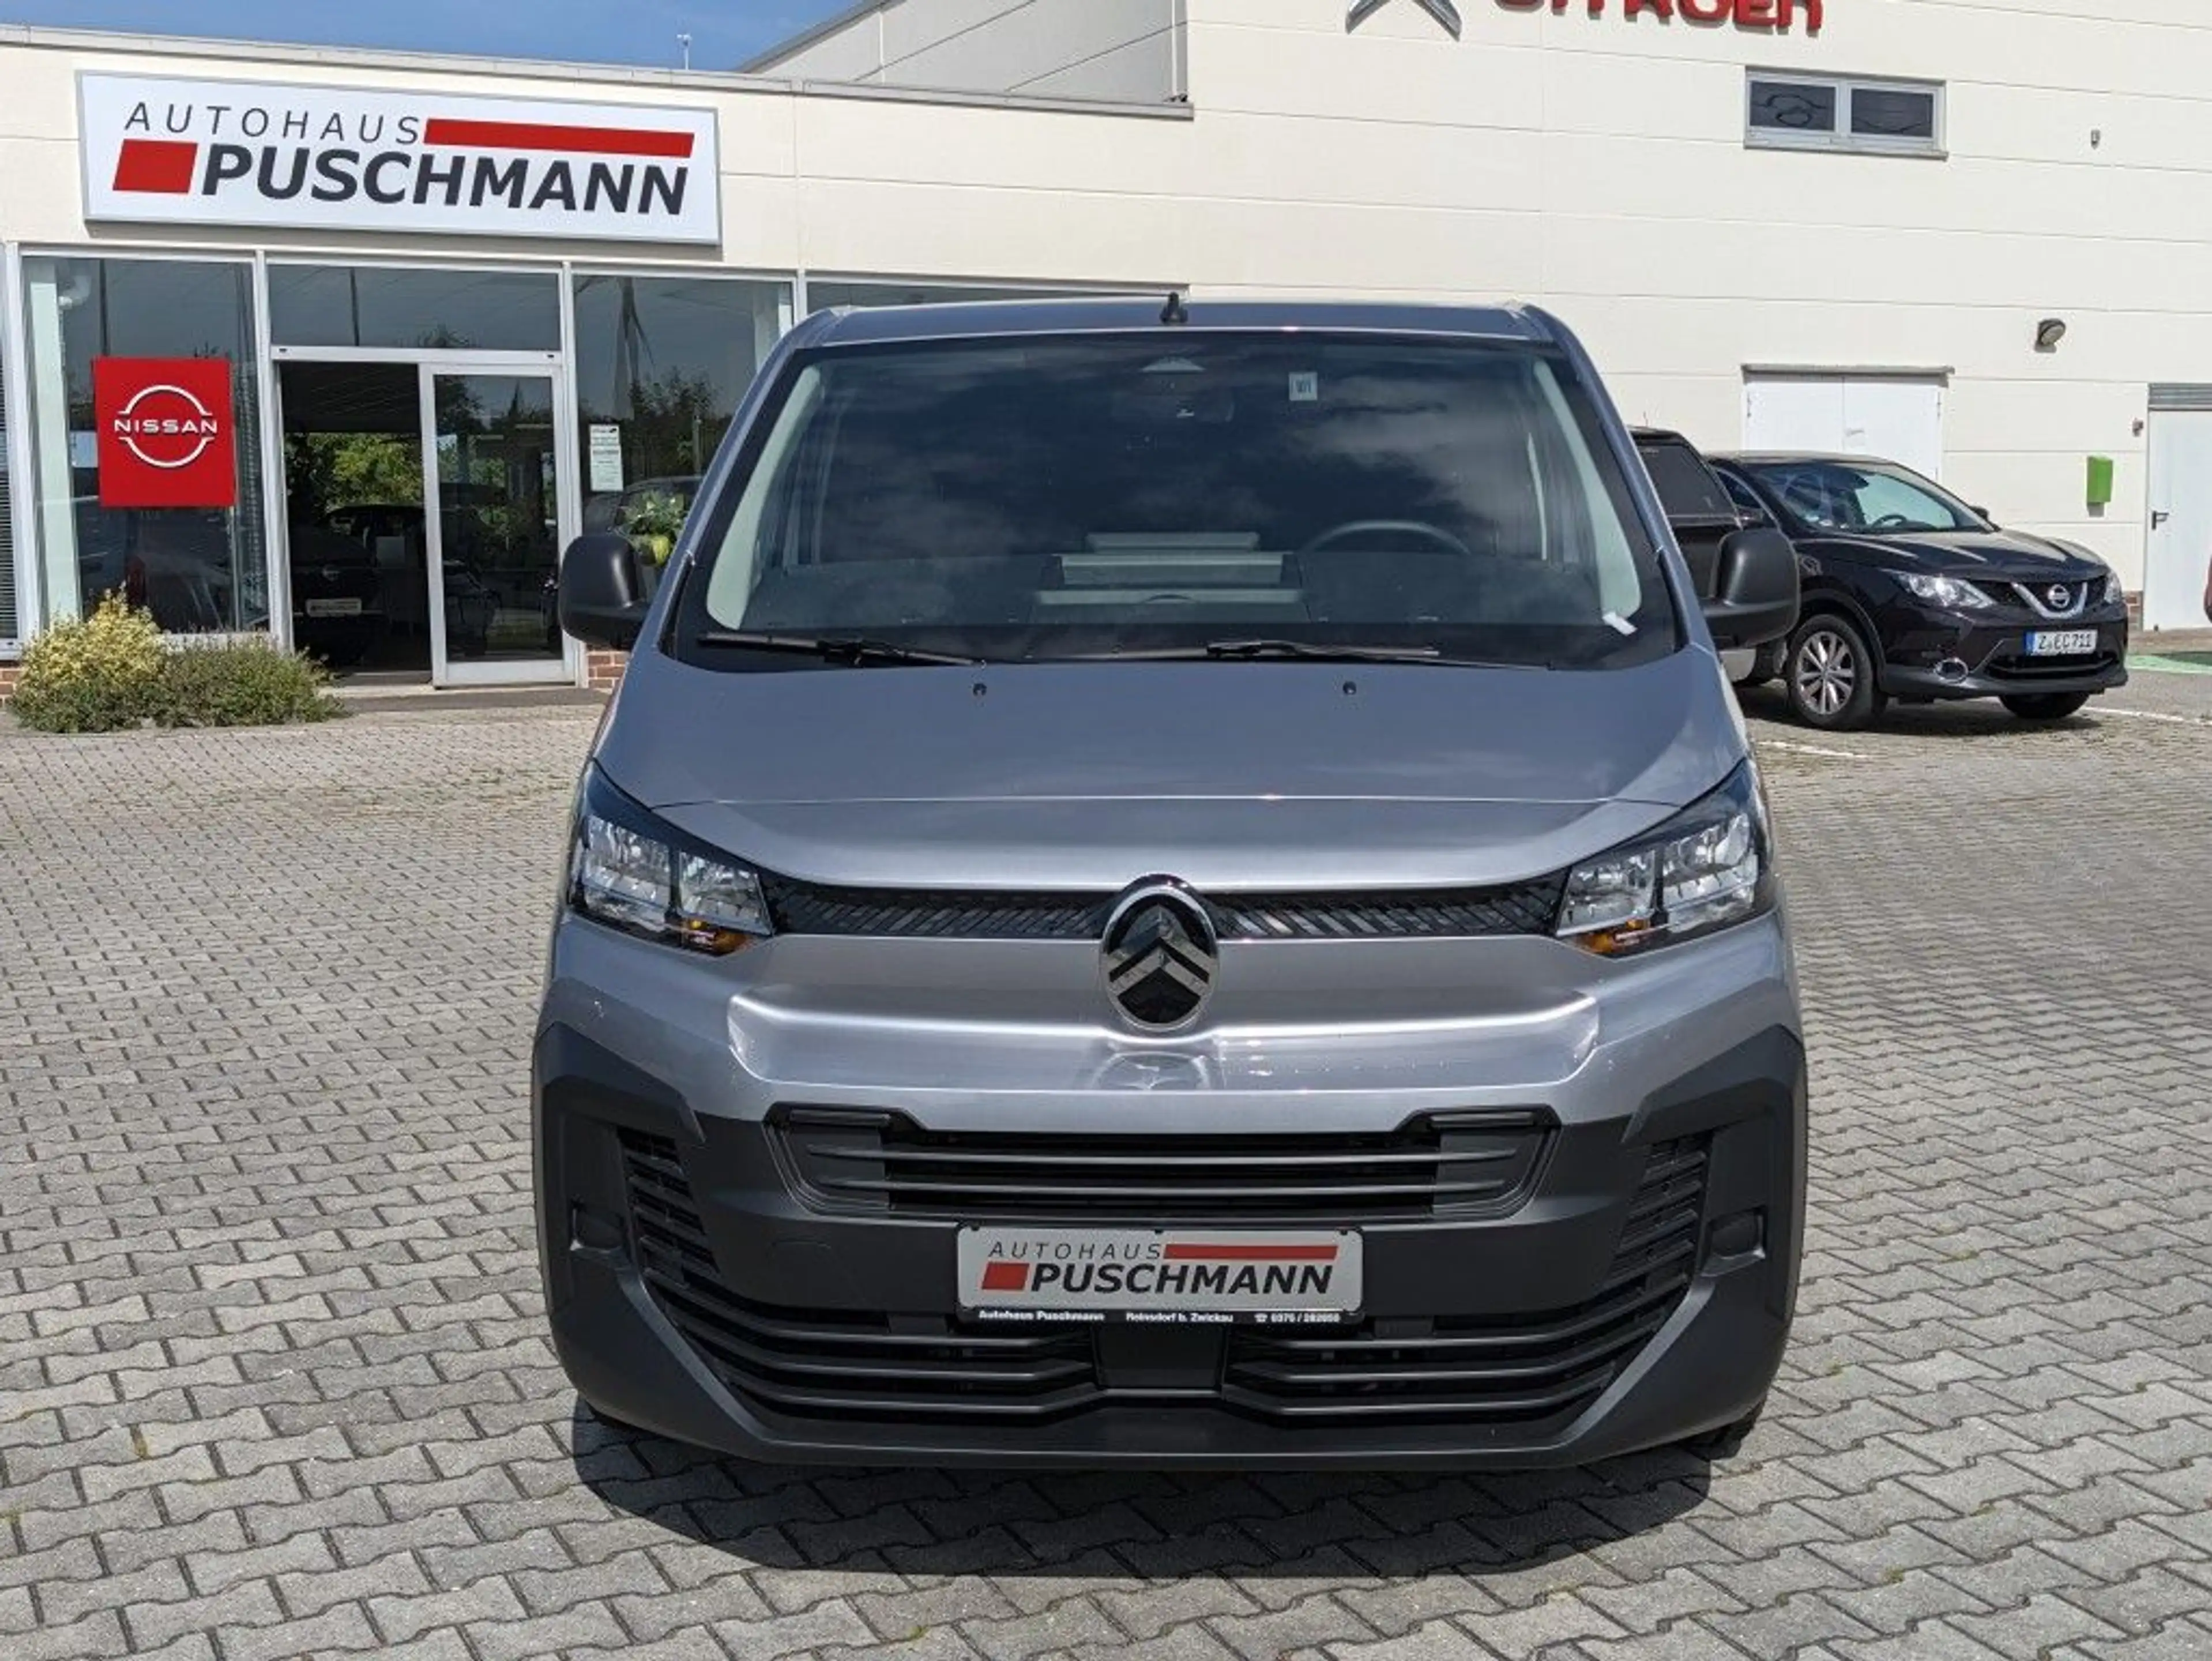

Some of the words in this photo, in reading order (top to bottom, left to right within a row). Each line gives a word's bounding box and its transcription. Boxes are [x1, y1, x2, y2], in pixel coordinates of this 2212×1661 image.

[123, 102, 420, 145] AUTOHAUS
[201, 142, 689, 216] PUSCHMANN
[114, 419, 218, 434] NISSAN
[988, 1241, 1161, 1260] AUTOHAUS
[1031, 1262, 1333, 1294] PUSCHMANN
[979, 1310, 1034, 1320] Autohaus
[1036, 1310, 1106, 1321] Puschmann
[1190, 1312, 1234, 1323] Zwickau
